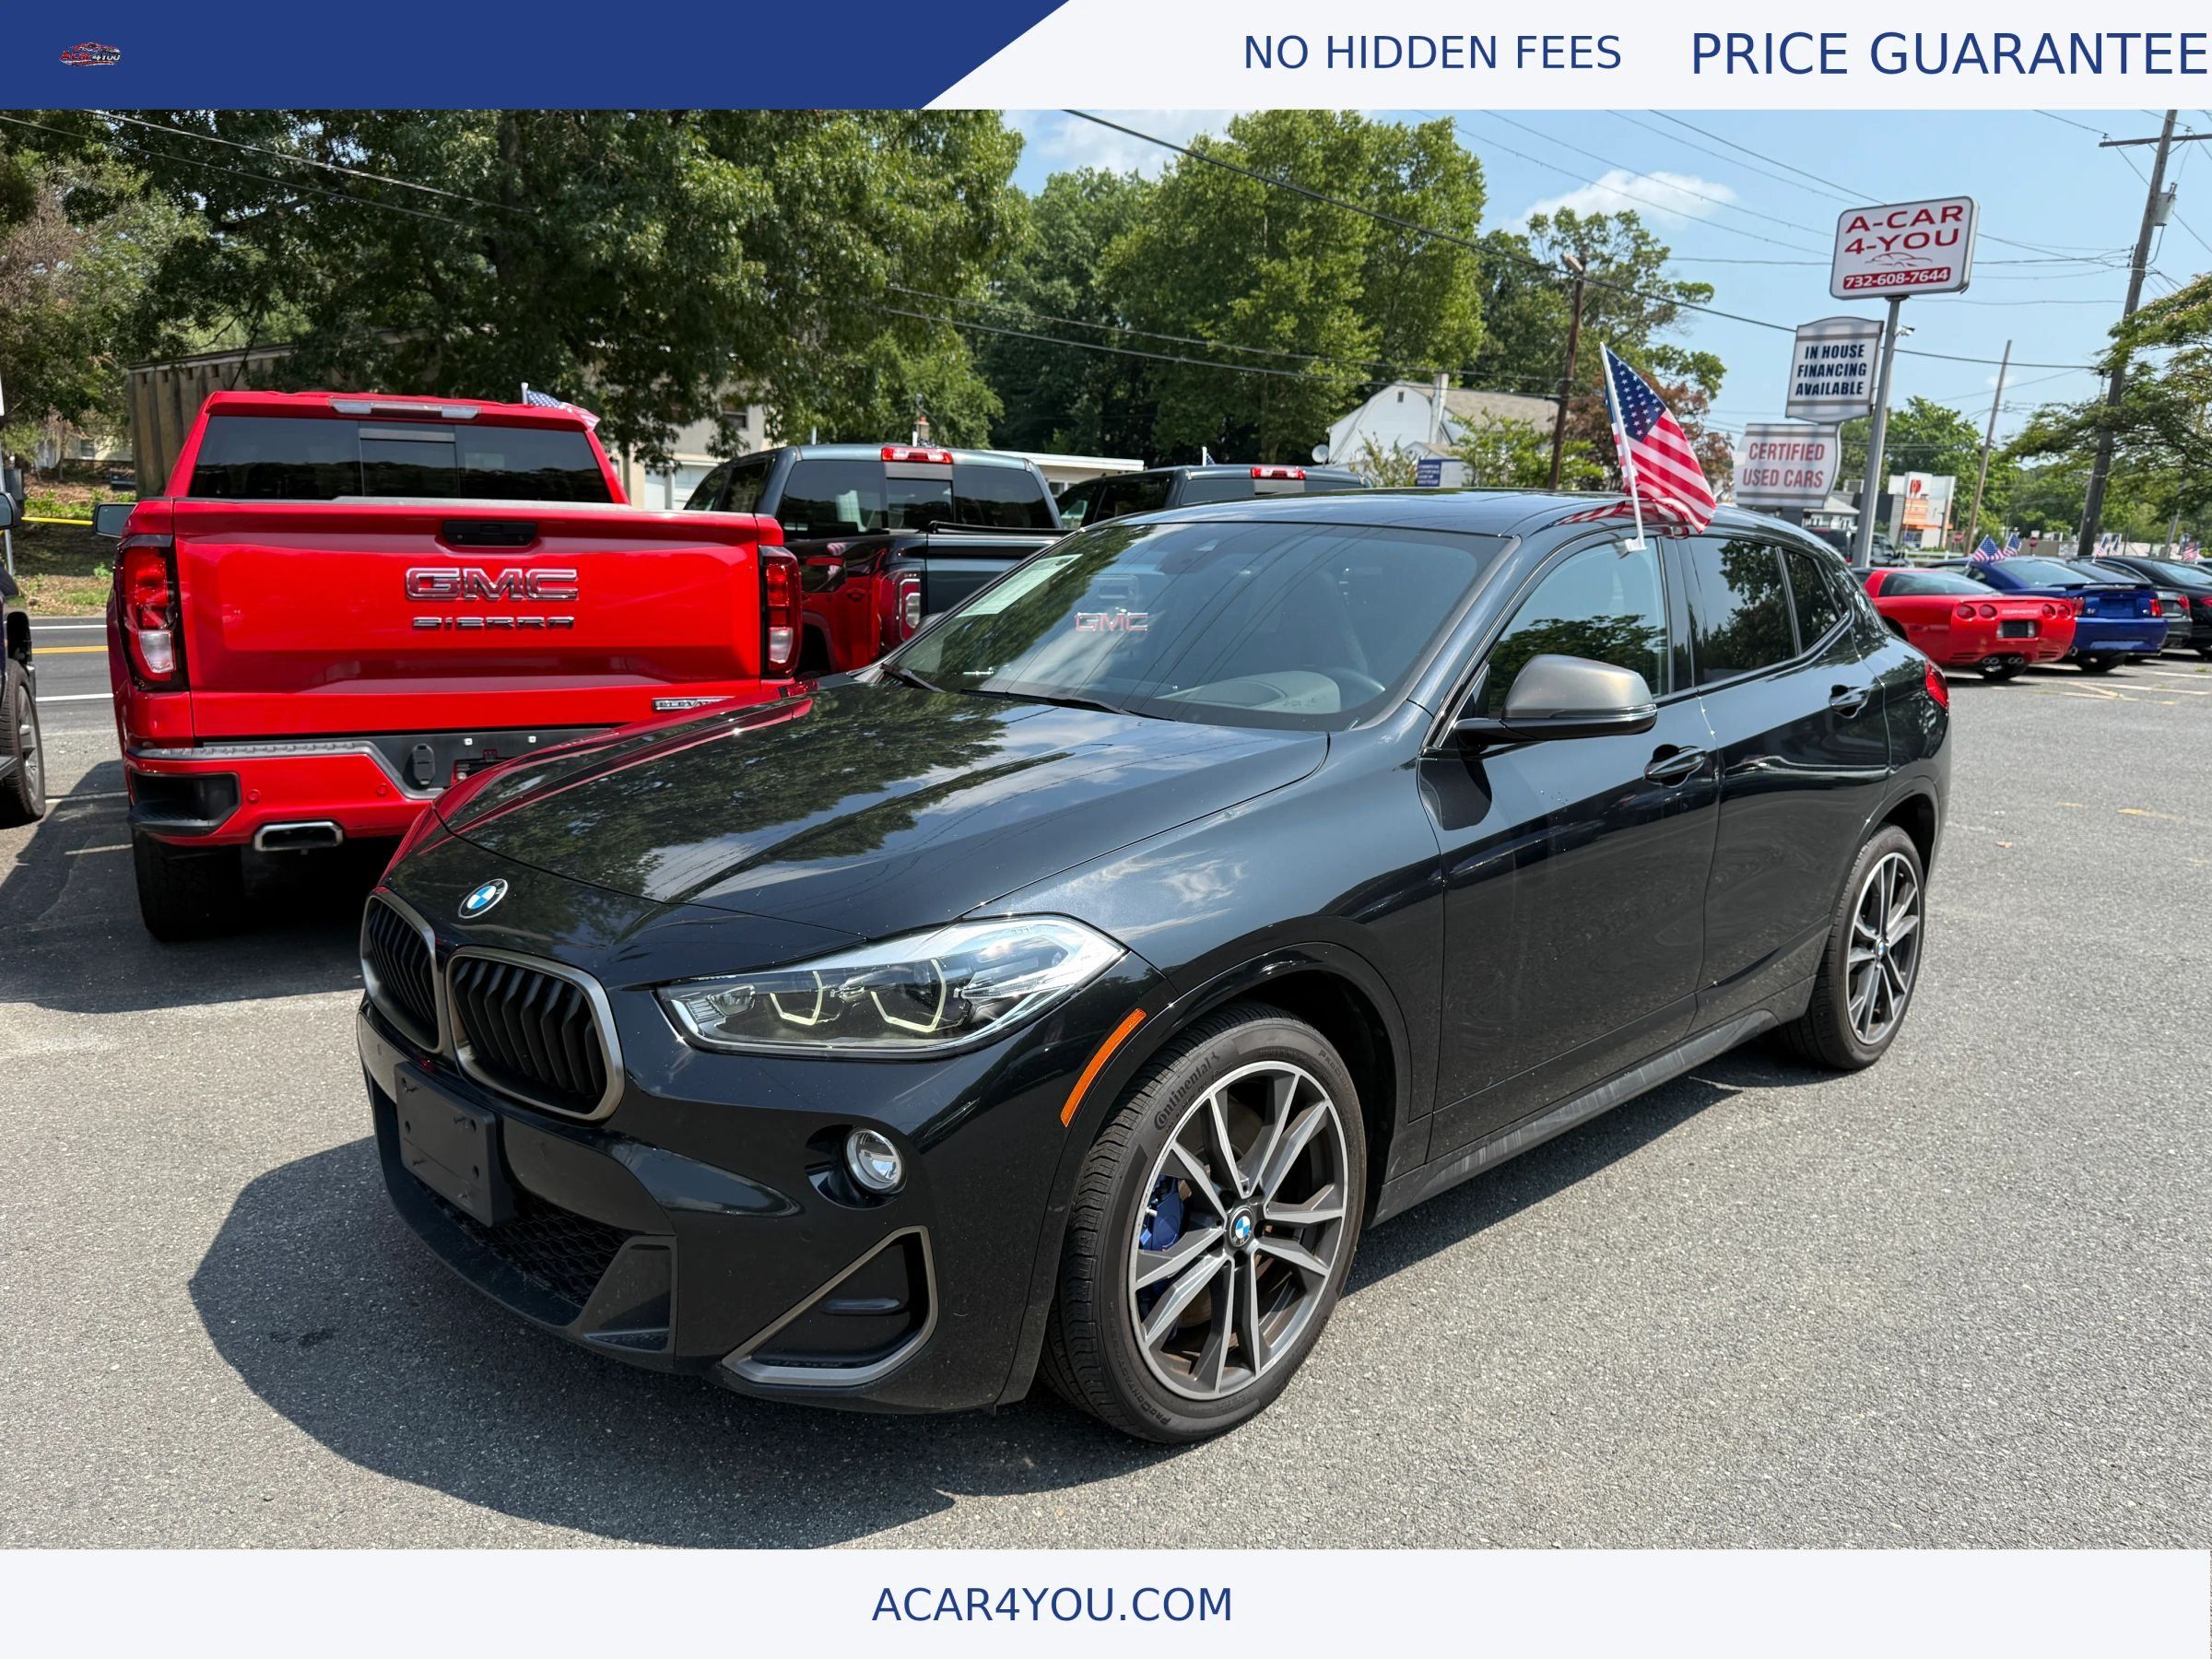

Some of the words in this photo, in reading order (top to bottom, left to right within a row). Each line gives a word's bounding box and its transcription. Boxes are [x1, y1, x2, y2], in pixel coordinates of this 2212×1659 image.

[1845, 206, 1964, 234] A-CAR
[1844, 229, 1959, 255] 4-YOU
[1845, 268, 1948, 288] 732-608-7644
[1805, 346, 1818, 359] IN
[1821, 344, 1865, 359] HOUSE
[1797, 362, 1867, 378] FINANCING
[1795, 382, 1864, 396] AVAILABLE
[1748, 442, 1825, 461] CERTIFIED
[1743, 468, 1780, 487] USED
[1783, 469, 1823, 488] CARS
[406, 567, 579, 601] GMC
[413, 617, 574, 628] SIERRA
[1075, 611, 1149, 632] GMC
[1154, 1057, 1212, 1131] Continental
